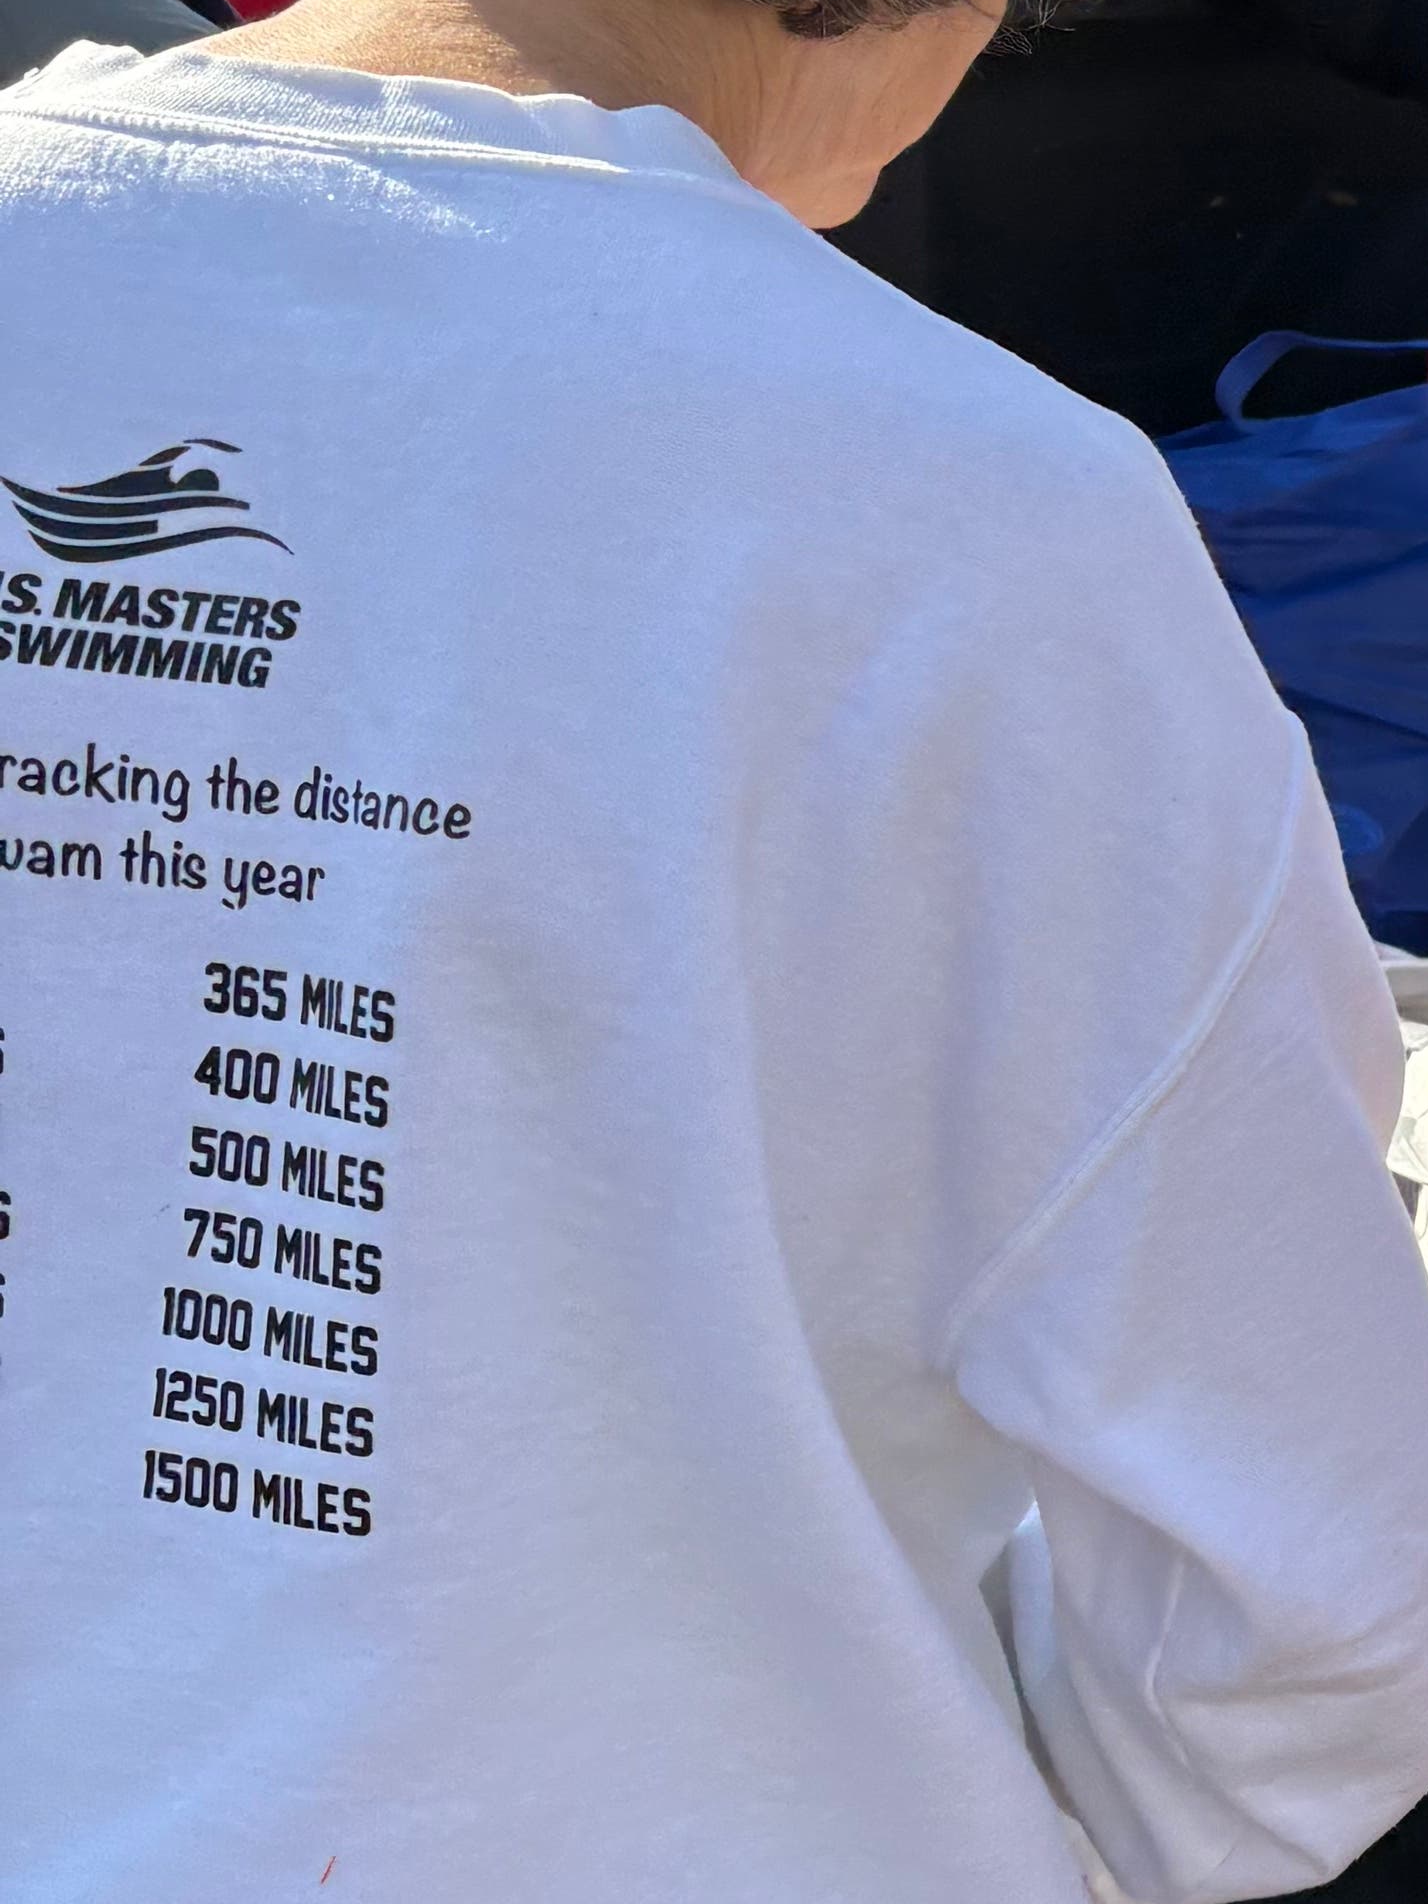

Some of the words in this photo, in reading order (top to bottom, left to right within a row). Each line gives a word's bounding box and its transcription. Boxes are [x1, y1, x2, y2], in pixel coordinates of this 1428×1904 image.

[0, 571, 42, 615] S.
[53, 578, 301, 641] MASTERS
[205, 756, 280, 815] the
[294, 765, 472, 840] distance
[119, 830, 207, 890] this
[222, 855, 325, 910] year
[203, 962, 288, 1021] 365
[300, 973, 395, 1043] MILES
[194, 1046, 280, 1104] 400
[289, 1057, 389, 1128] MILES
[189, 1125, 270, 1187] 500
[281, 1140, 385, 1212] MILES
[183, 1207, 263, 1270] 750
[274, 1223, 382, 1295] MILES
[162, 1286, 253, 1351] 1000
[263, 1306, 379, 1376] MILES
[153, 1367, 244, 1432] 1250
[256, 1388, 374, 1457] MILES
[143, 1449, 238, 1513] 1500
[252, 1468, 371, 1536] MILES
